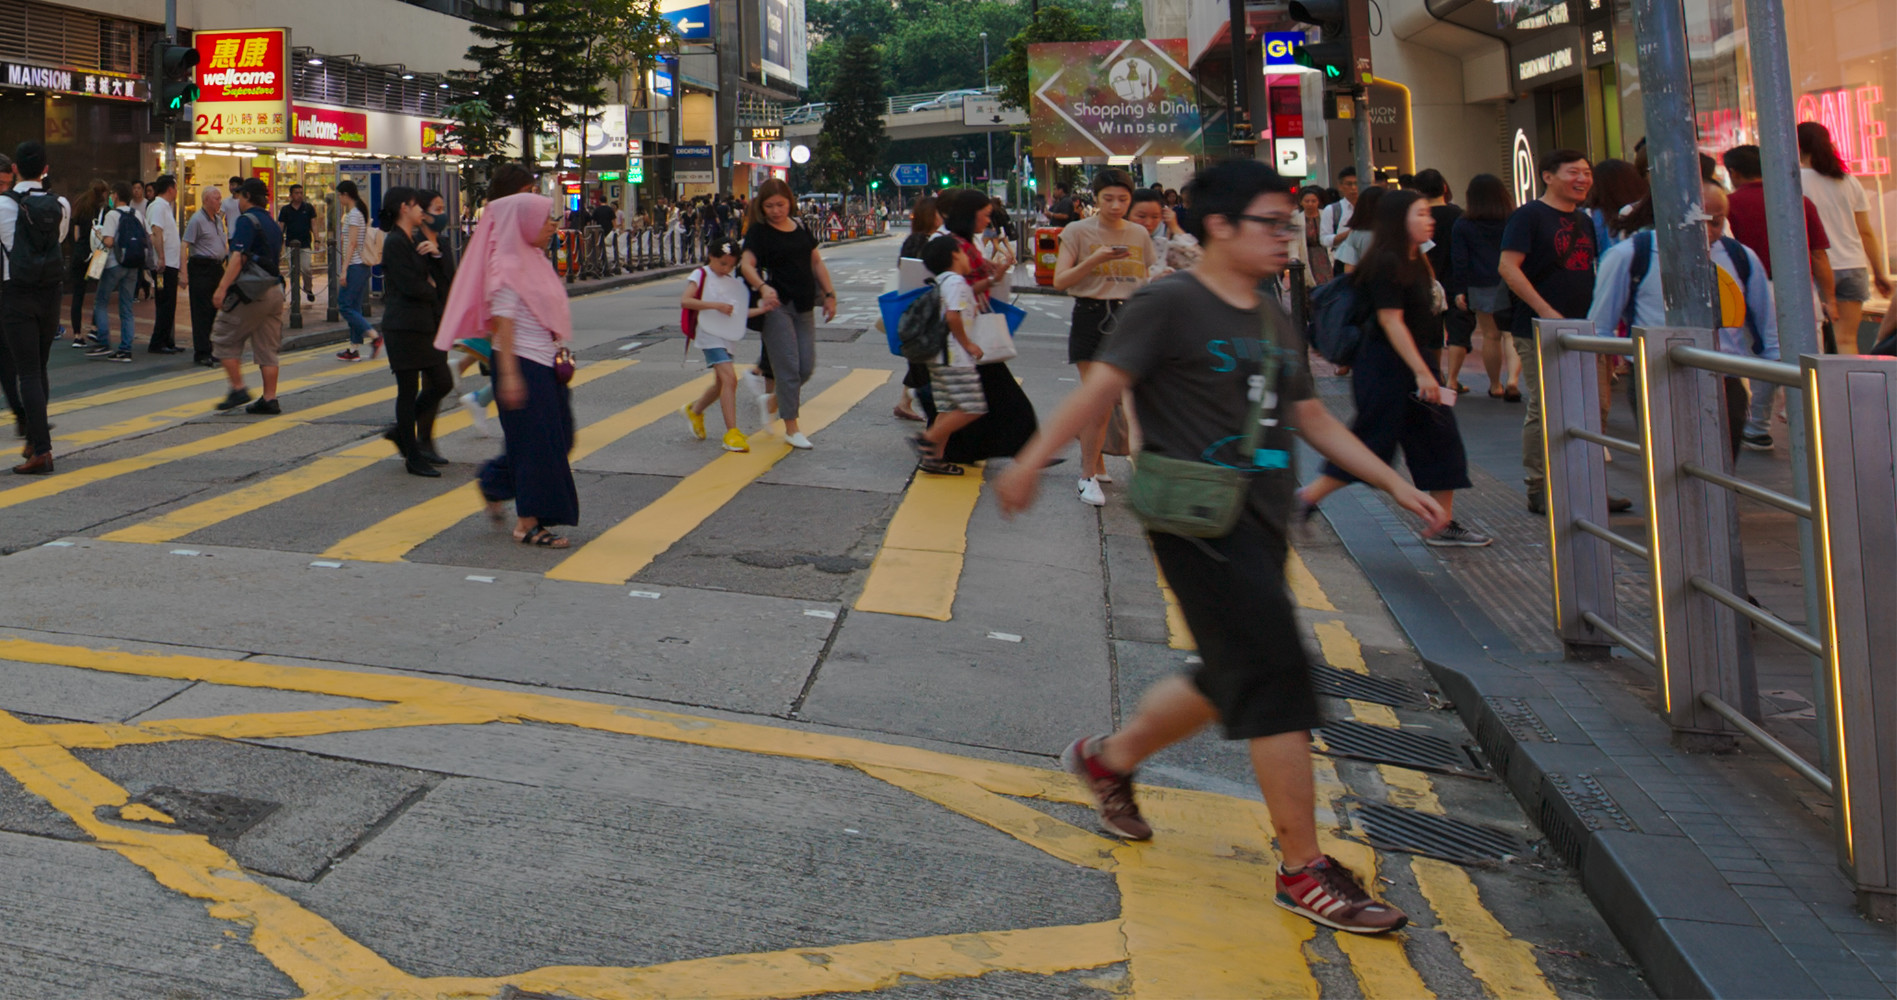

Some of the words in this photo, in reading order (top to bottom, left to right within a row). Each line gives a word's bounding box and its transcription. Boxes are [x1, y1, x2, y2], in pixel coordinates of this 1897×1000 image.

[209, 37, 269, 68] 惠康
[8, 63, 72, 91] MANSION
[203, 68, 275, 85] wellcome
[222, 85, 275, 98] Superstore
[1073, 101, 1144, 119] Shopping
[1147, 103, 1156, 113] &
[1369, 106, 1396, 115] HION
[195, 113, 223, 135] 24
[226, 113, 284, 125] 小時營業
[259, 127, 284, 135] HOURS
[298, 114, 338, 140] wellcome
[1347, 136, 1398, 153] FLL
